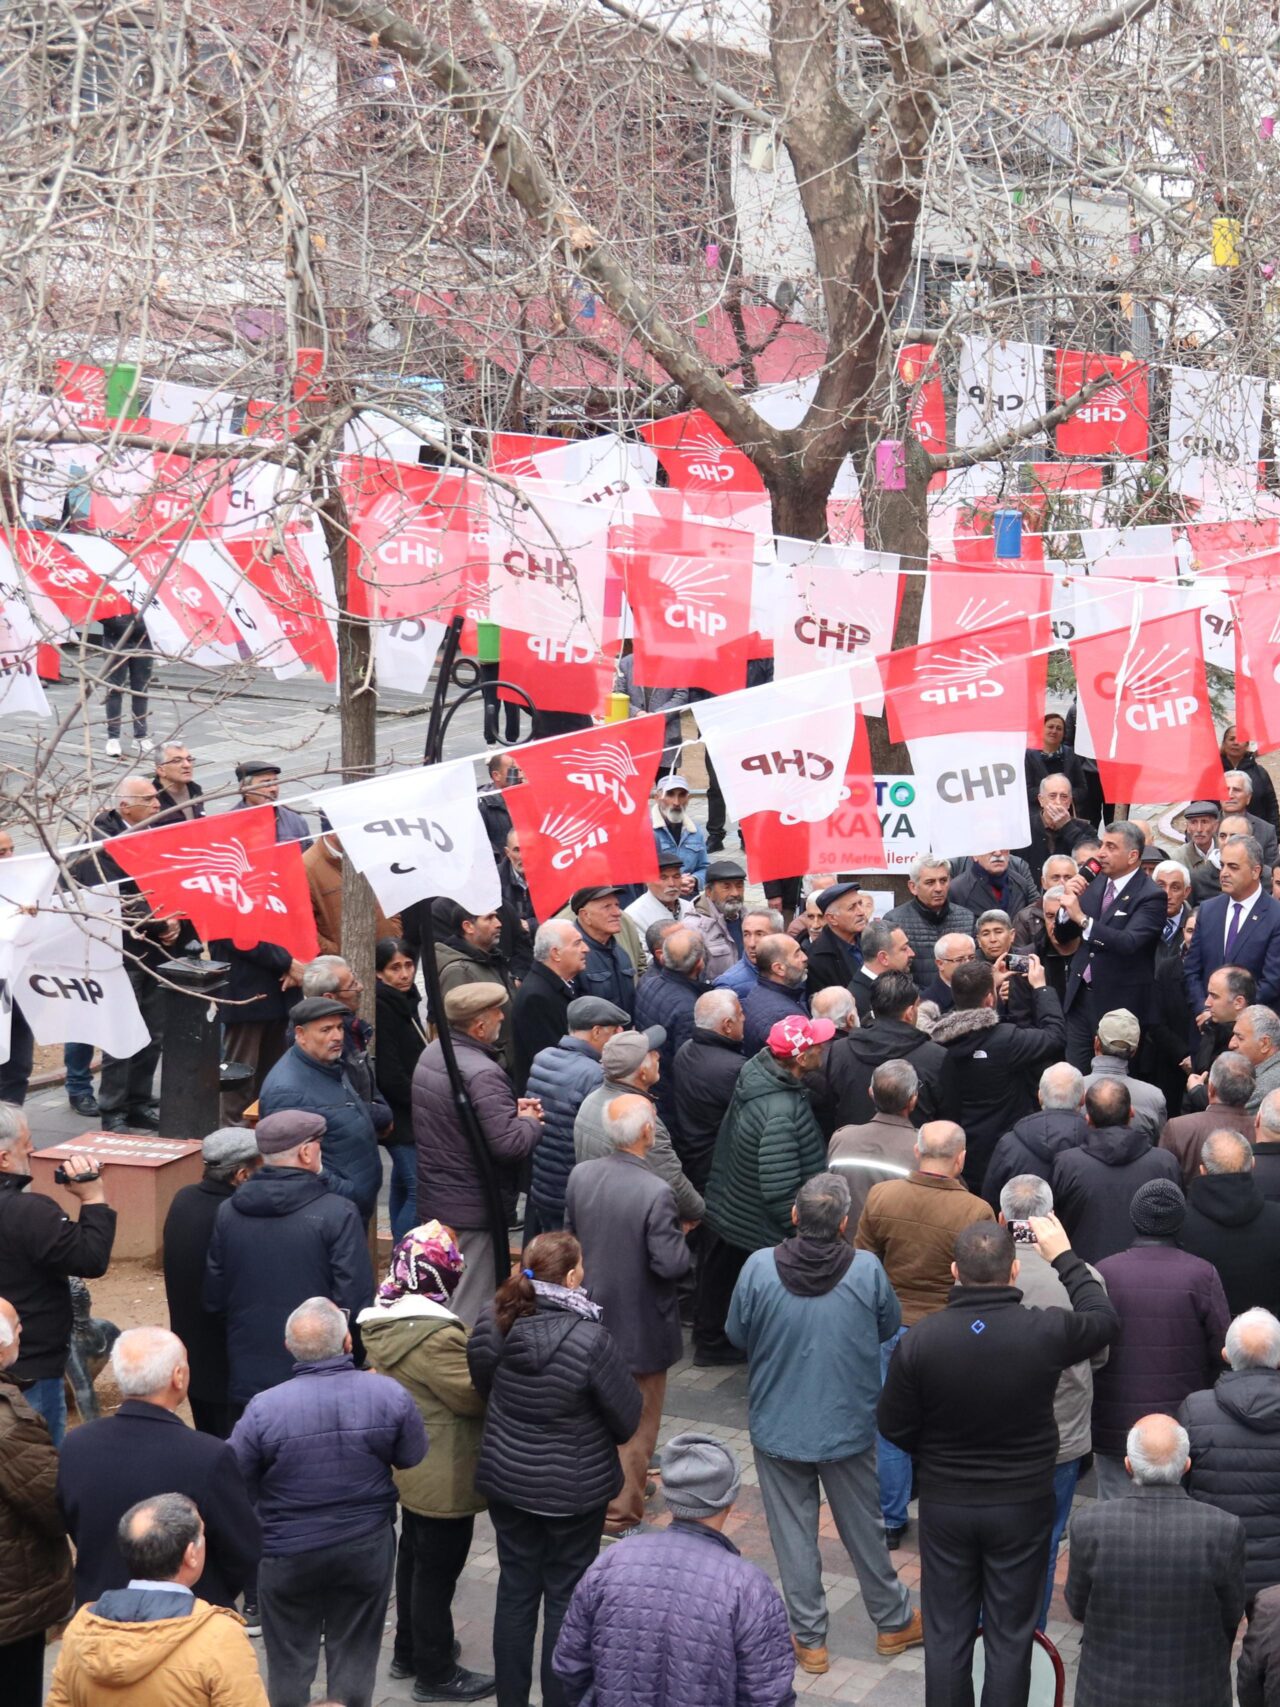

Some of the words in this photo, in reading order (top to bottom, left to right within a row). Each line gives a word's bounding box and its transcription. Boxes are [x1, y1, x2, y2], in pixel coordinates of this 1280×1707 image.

[378, 541, 444, 568] CHP
[665, 603, 727, 637] CHP
[794, 615, 872, 654] CHP
[1125, 695, 1200, 732] CHP
[936, 762, 1018, 805] CHP
[827, 813, 917, 838] KAYA
[28, 974, 105, 1005] CHP
